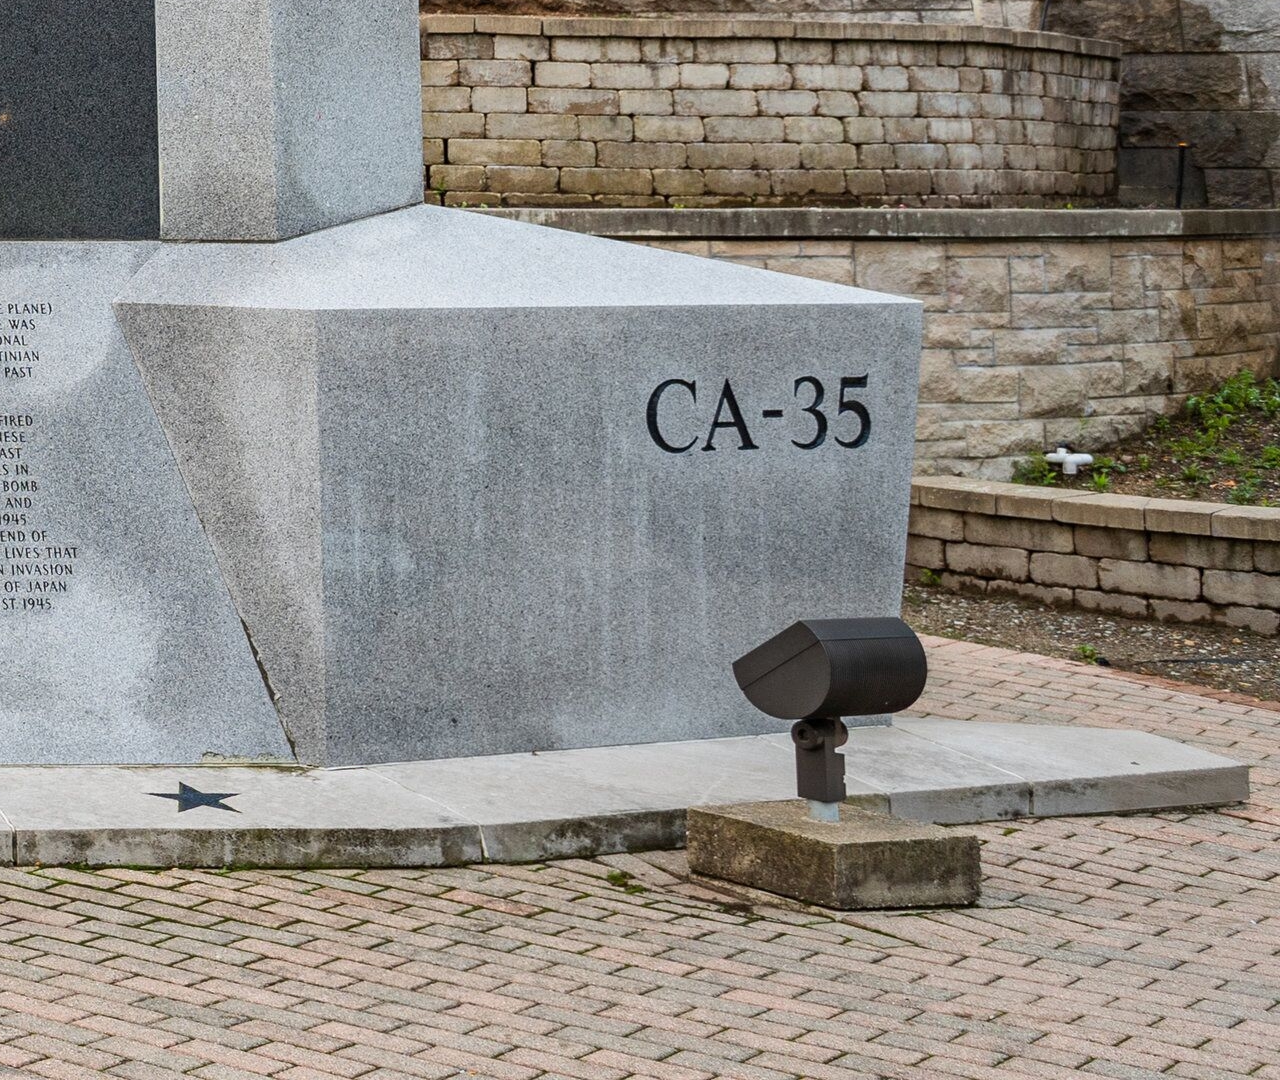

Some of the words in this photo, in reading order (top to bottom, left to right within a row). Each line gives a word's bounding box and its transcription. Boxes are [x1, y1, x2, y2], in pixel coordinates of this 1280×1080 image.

[645, 371, 872, 454] CA-35
[16, 462, 30, 475] IN
[11, 562, 74, 575] INVASION
